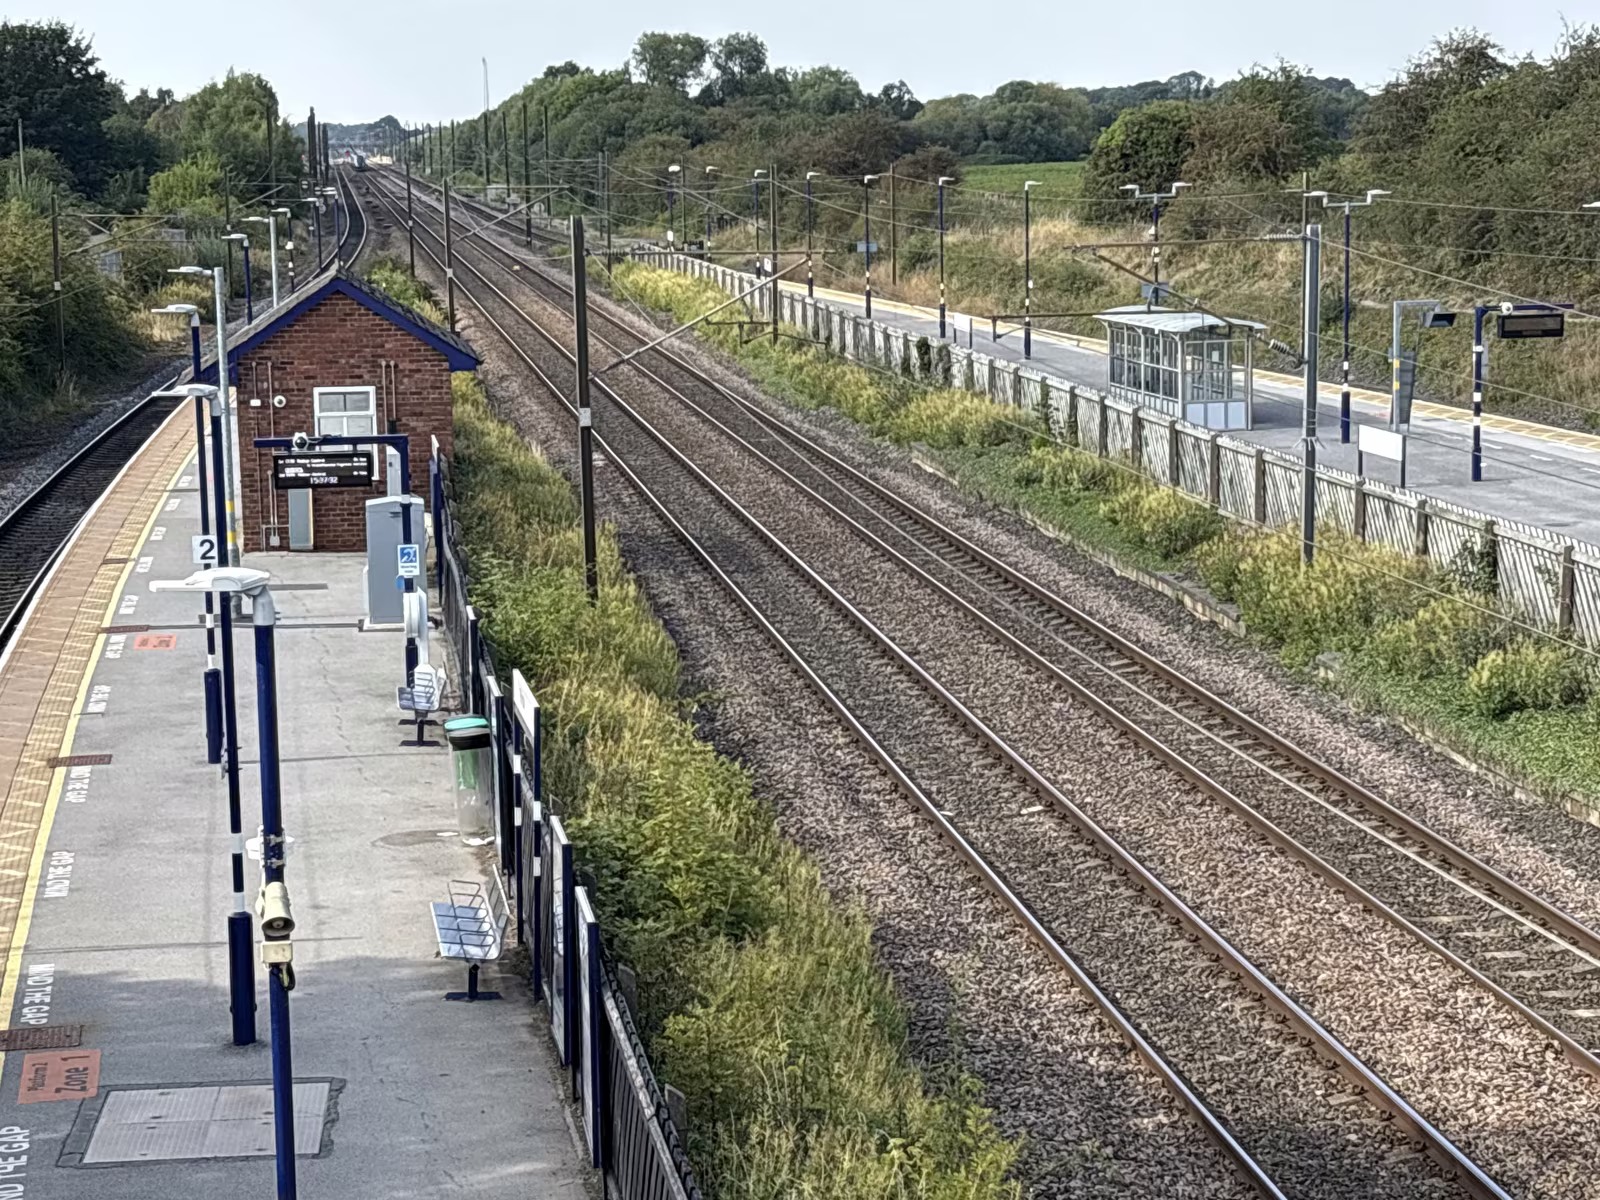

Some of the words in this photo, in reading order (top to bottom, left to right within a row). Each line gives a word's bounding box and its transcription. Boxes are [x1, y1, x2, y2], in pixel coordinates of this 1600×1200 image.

[199, 539, 216, 560] 2
[27, 963, 55, 985] MIND
[23, 985, 52, 1004] THE
[20, 1005, 50, 1025] GAP
[54, 1067, 89, 1094] Zone
[0, 1126, 30, 1153] GAP
[0, 1183, 24, 1200] ND
